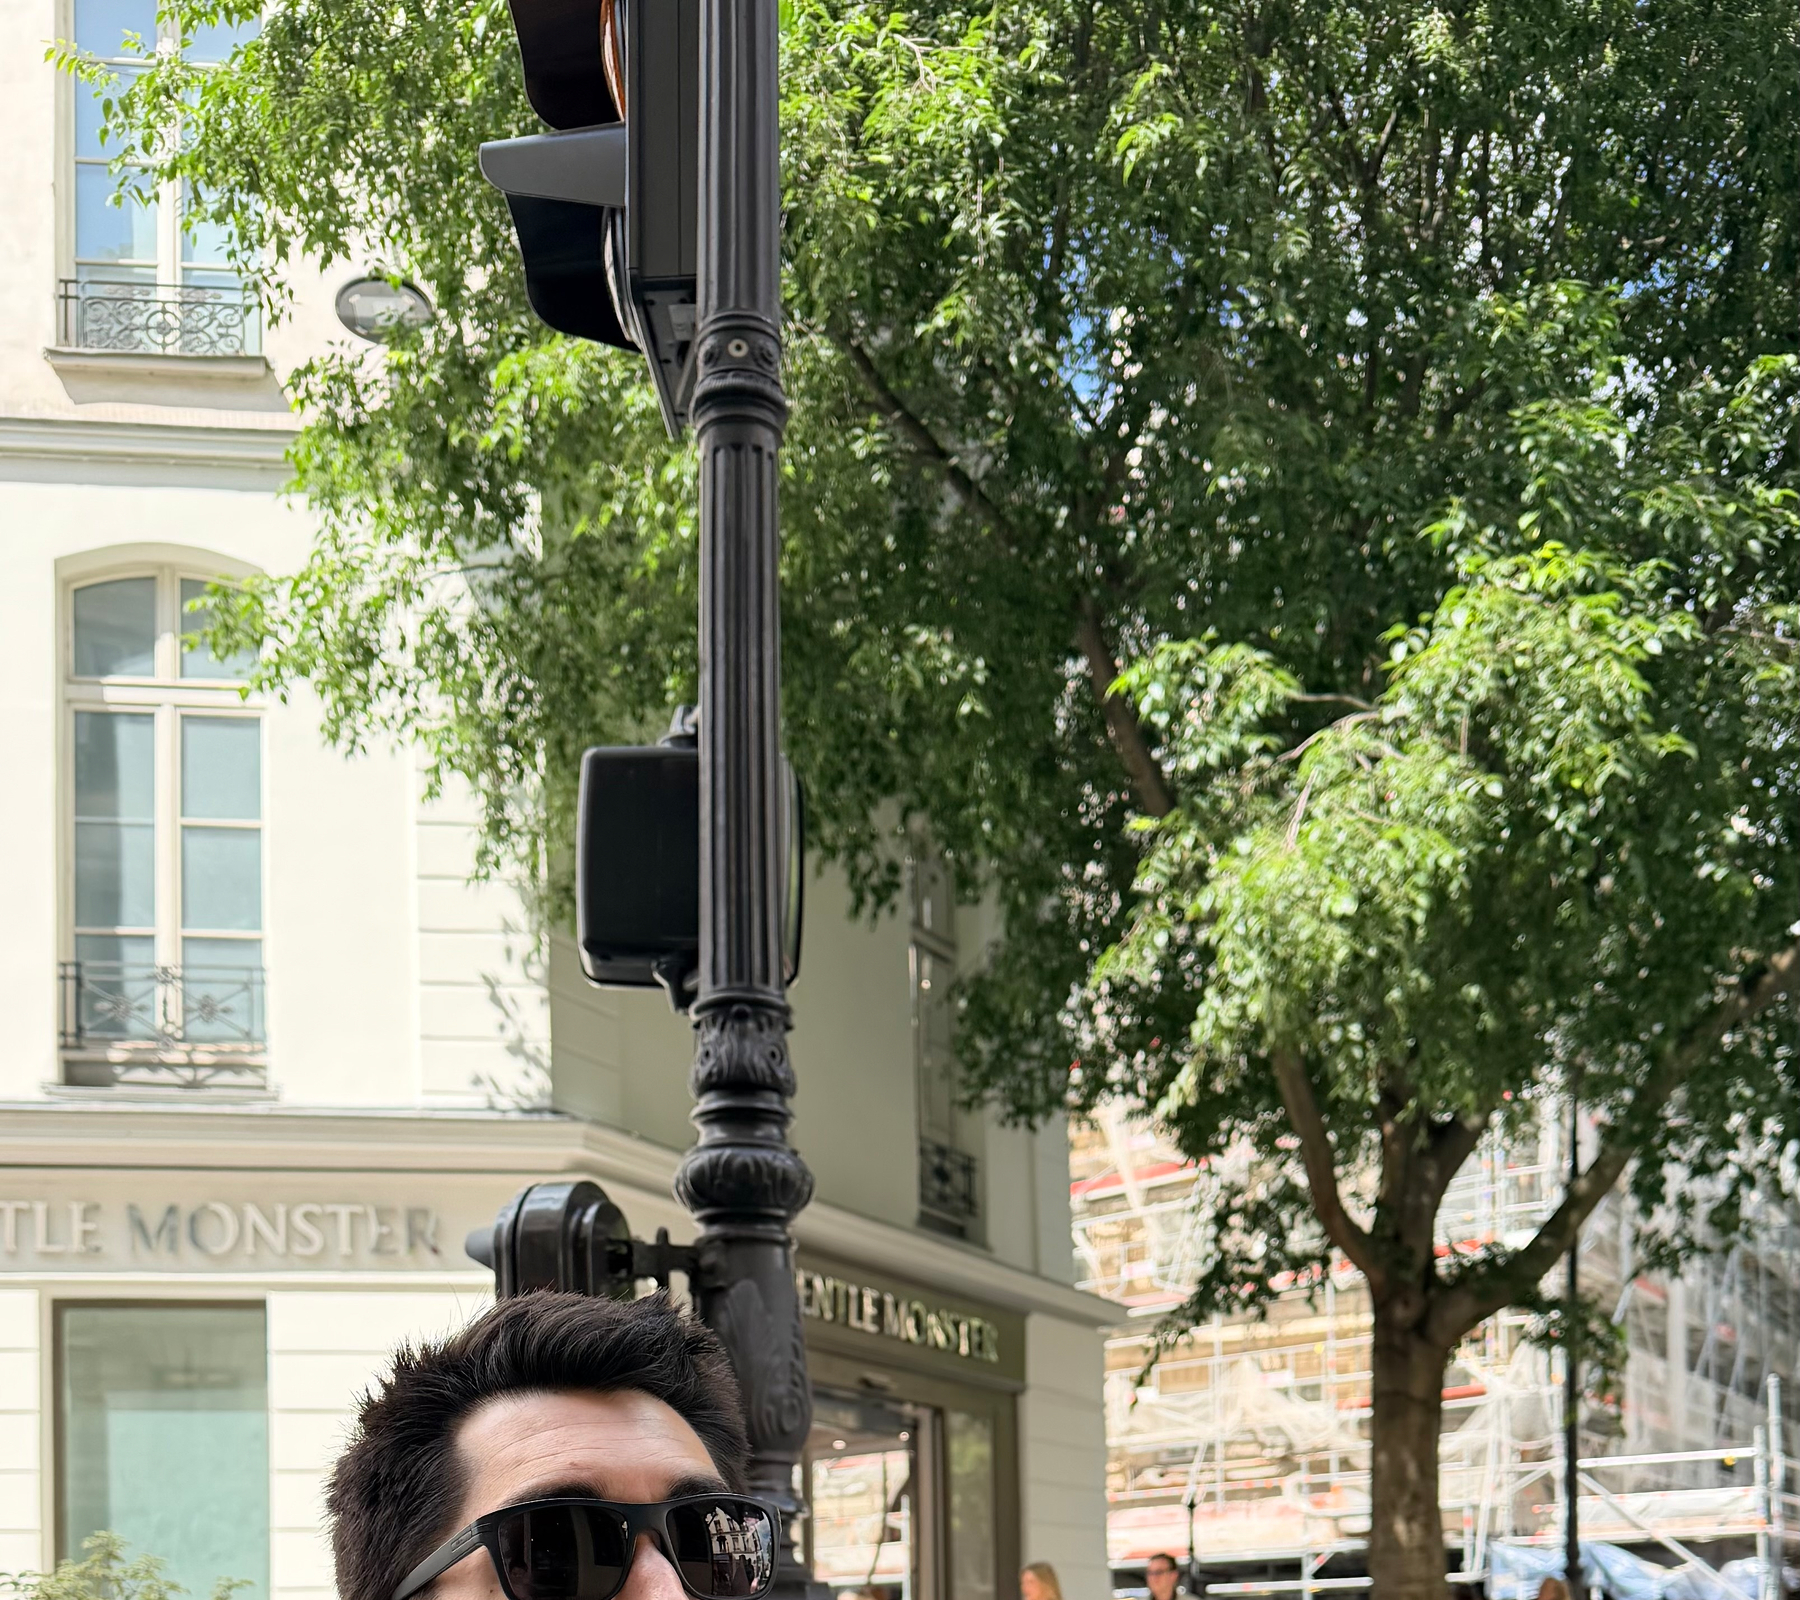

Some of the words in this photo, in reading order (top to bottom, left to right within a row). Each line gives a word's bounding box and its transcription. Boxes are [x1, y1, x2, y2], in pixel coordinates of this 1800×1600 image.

[0, 1200, 102, 1253] TLE
[127, 1201, 442, 1257] MONSTER
[795, 1268, 880, 1334] ENTLE
[882, 1291, 1000, 1363] MONSTER
